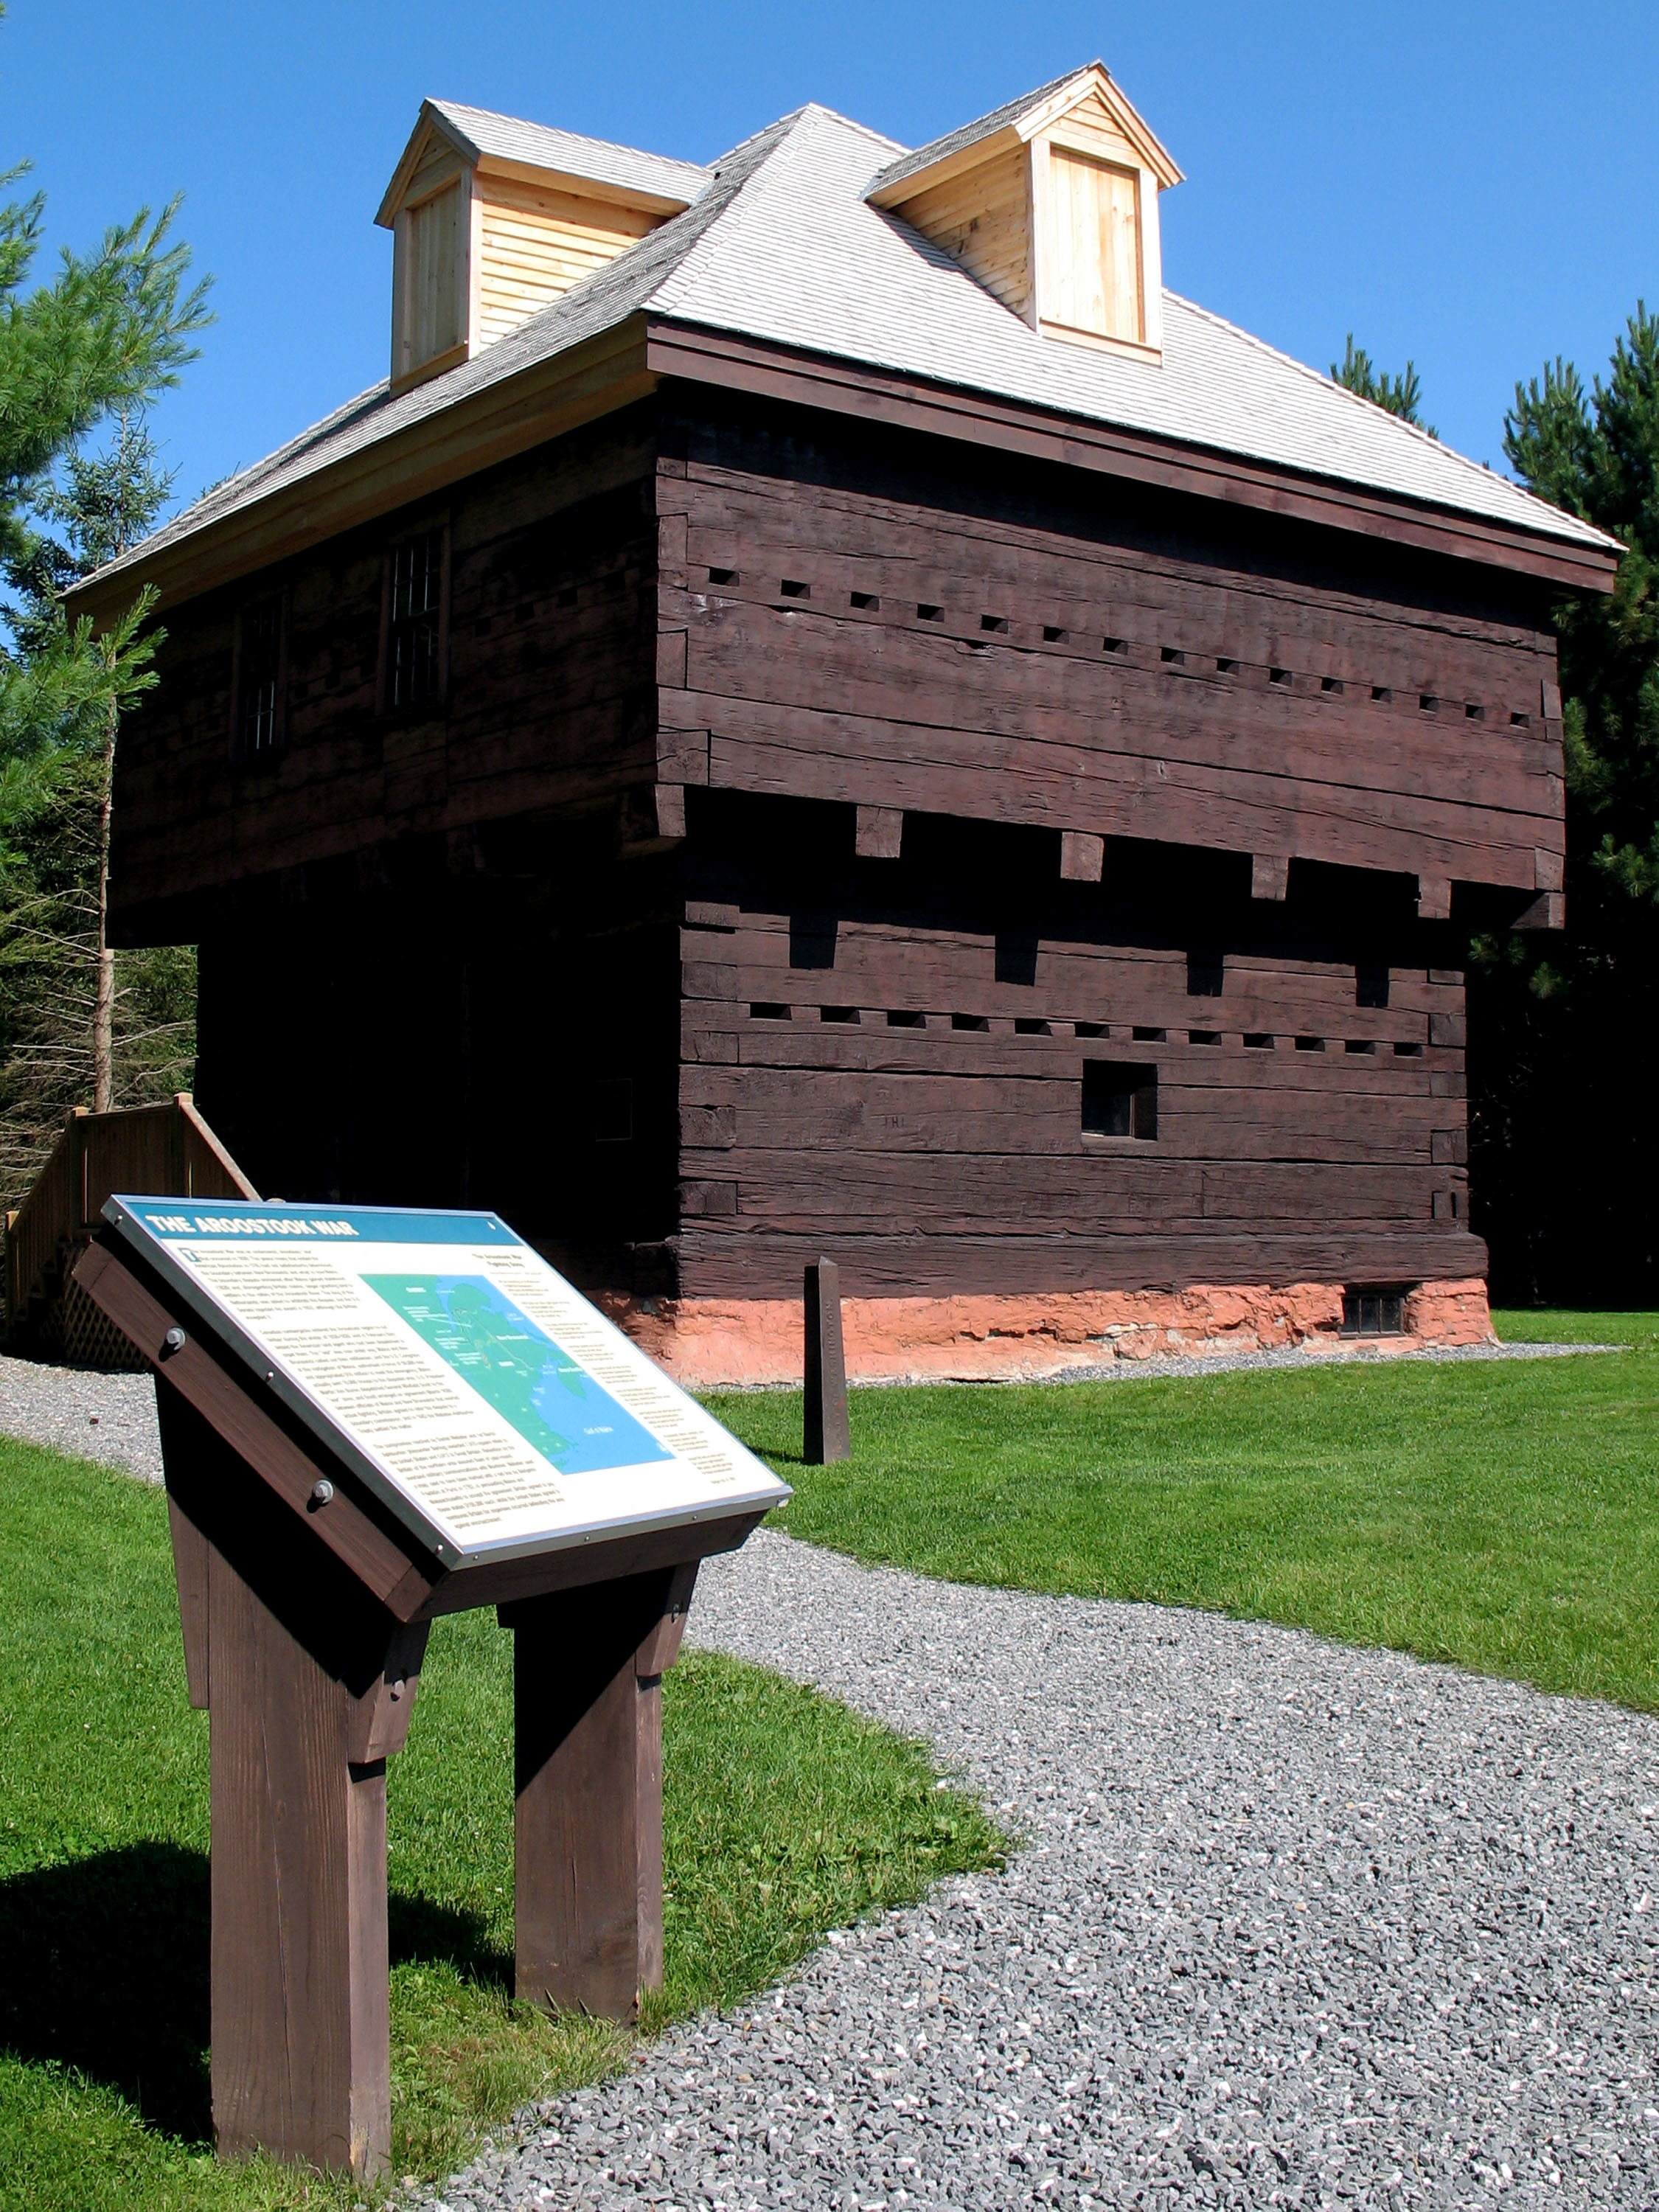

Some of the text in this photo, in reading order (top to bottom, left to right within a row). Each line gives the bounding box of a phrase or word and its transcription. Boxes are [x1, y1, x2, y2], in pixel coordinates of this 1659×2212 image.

[145, 1214, 360, 1236] THE AROOSTOOK WAR
